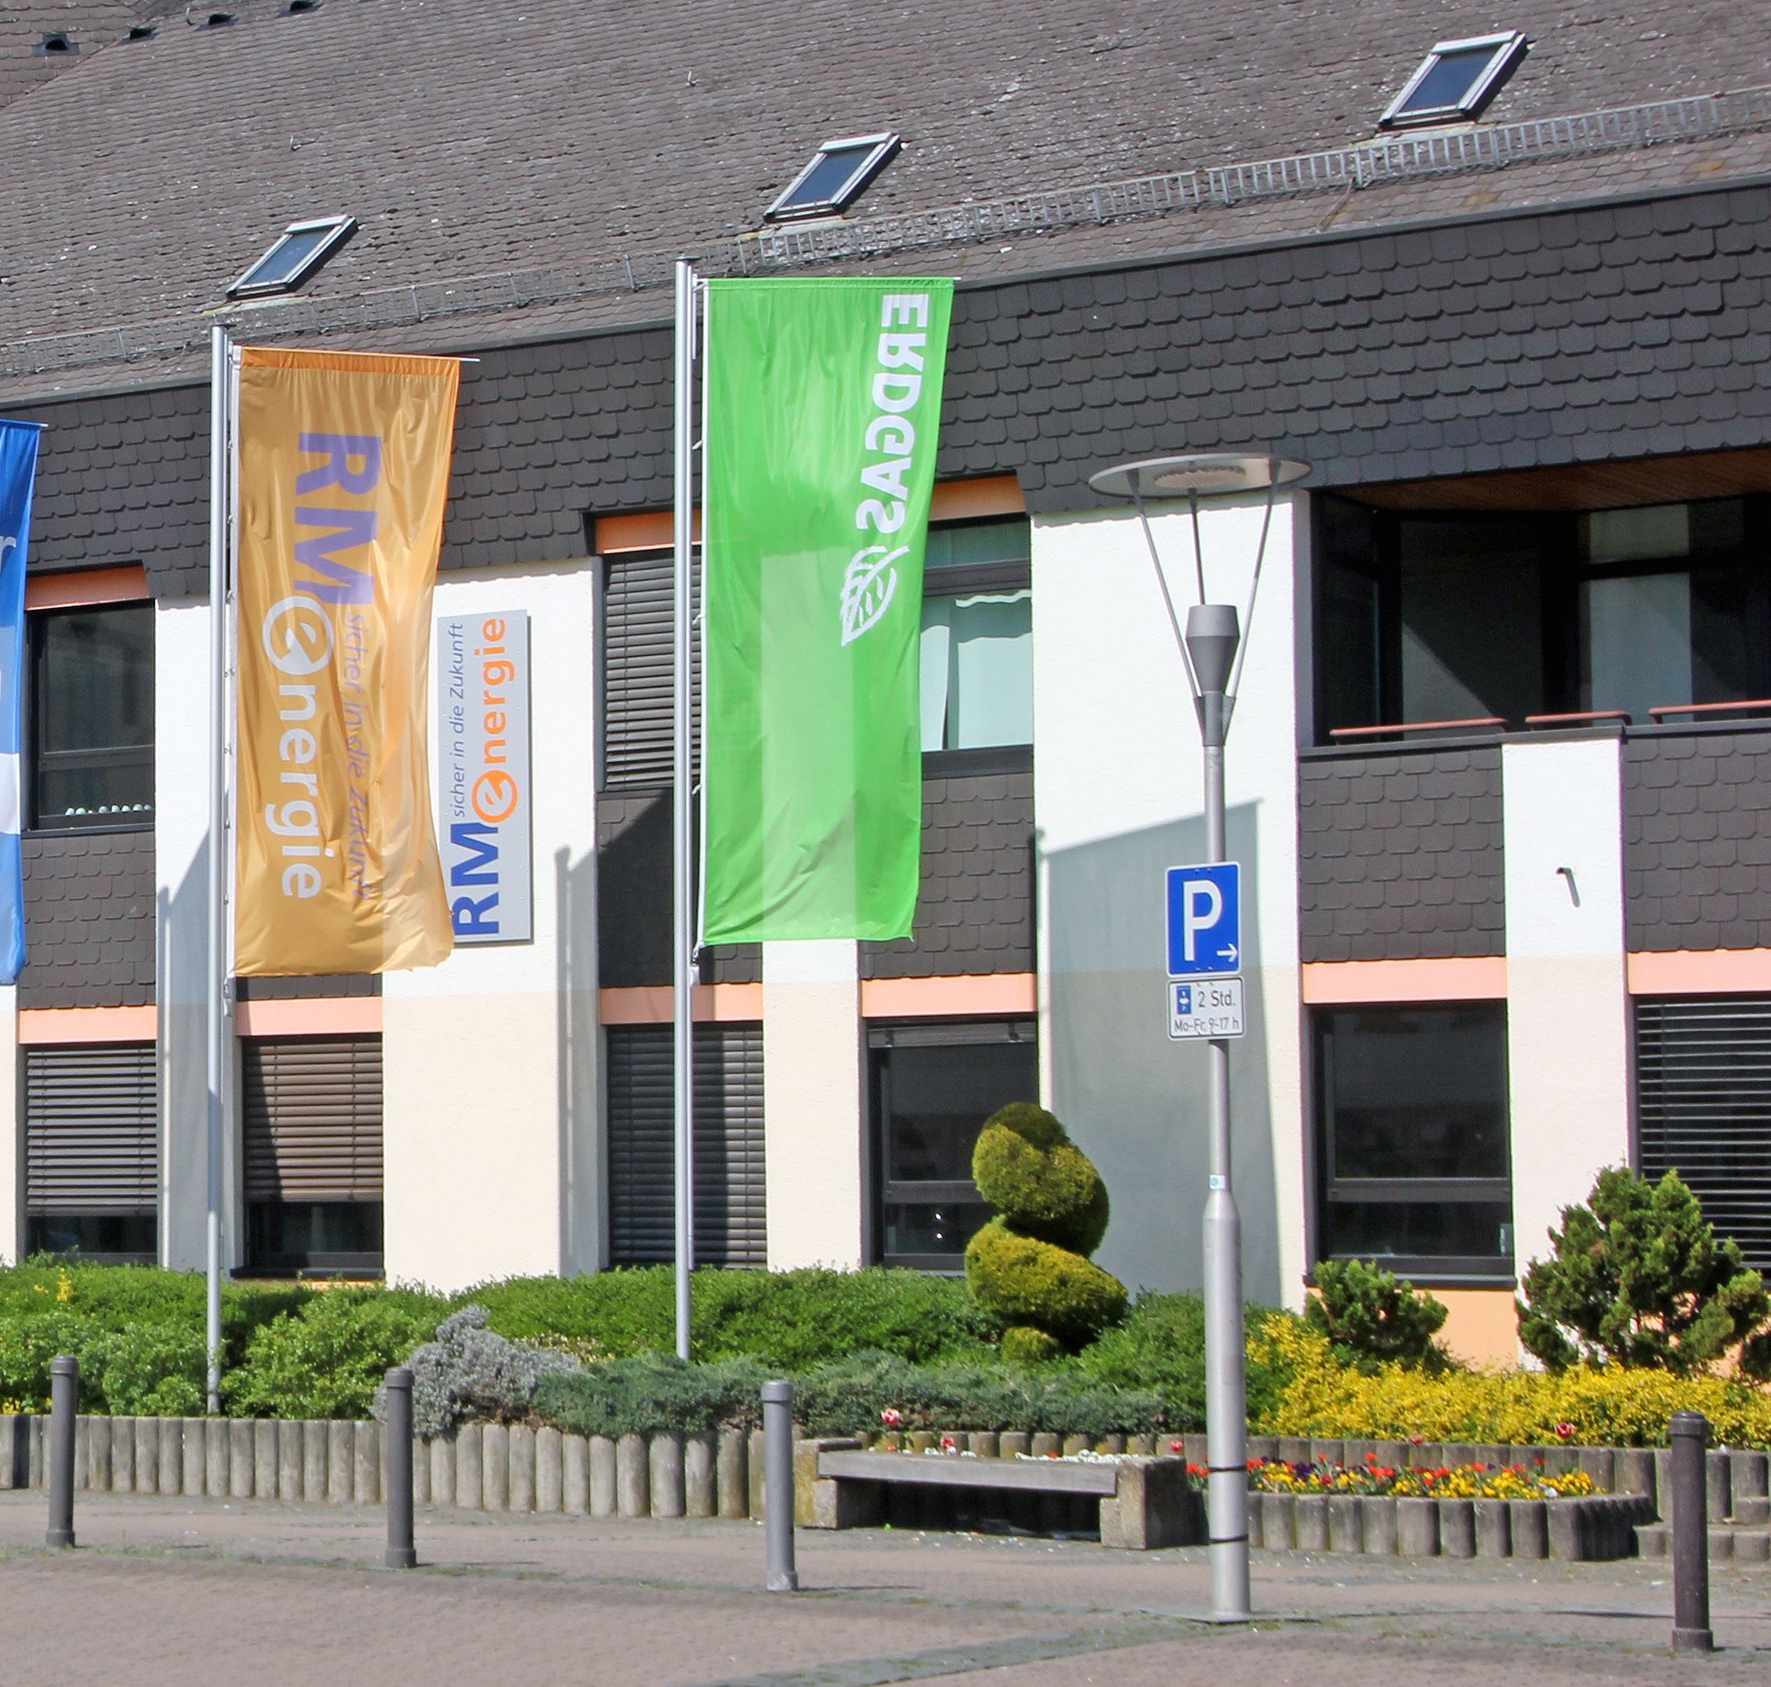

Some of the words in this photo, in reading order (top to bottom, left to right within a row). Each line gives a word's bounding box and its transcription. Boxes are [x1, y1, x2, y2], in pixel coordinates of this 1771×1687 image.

[343, 613, 369, 692] sicher
[448, 622, 465, 700] Zukunft
[343, 701, 370, 727] in
[449, 705, 465, 734] die
[347, 734, 372, 779] die
[449, 741, 465, 758] in
[449, 763, 466, 819] sicher
[1183, 879, 1223, 962] P
[1198, 991, 1206, 1008] 2
[1211, 989, 1237, 1008] Std.
[1232, 1016, 1240, 1030] h
